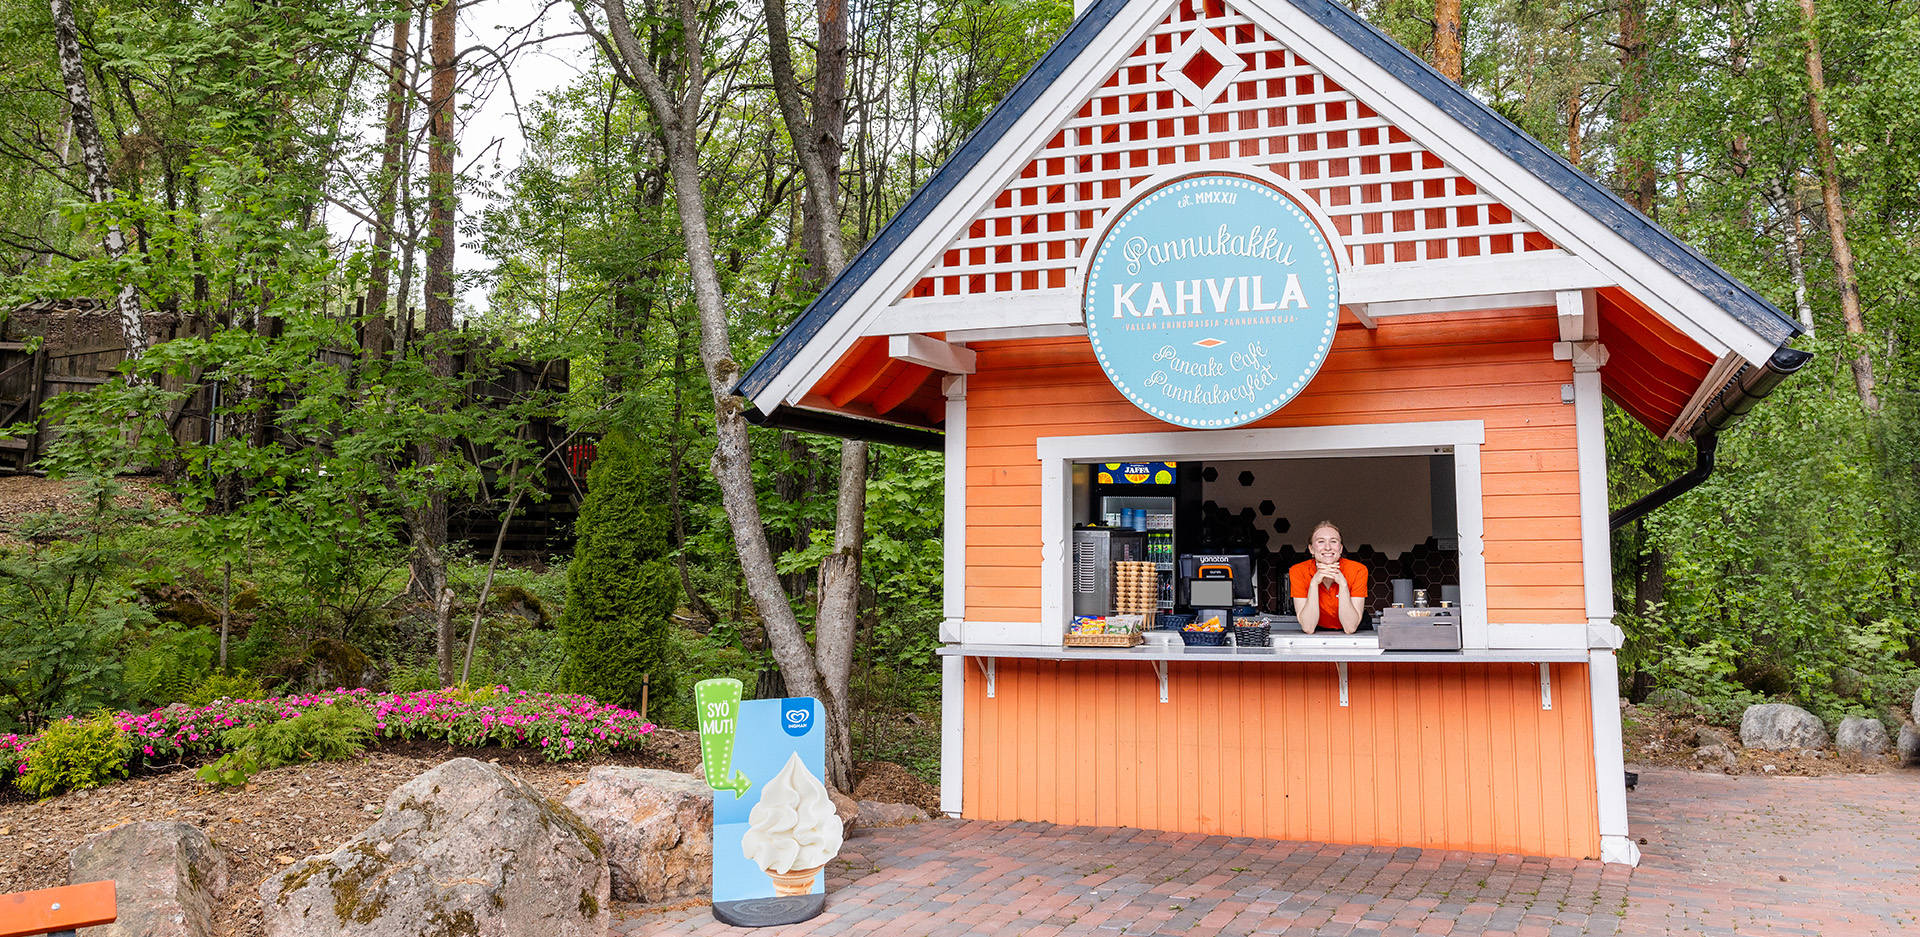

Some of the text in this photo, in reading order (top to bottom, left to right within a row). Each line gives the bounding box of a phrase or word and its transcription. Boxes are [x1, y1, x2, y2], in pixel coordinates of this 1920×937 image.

[1195, 191, 1237, 204] MMXXII
[1123, 224, 1296, 276] Pannukakku
[1112, 273, 1311, 319] KAHVILA
[1152, 341, 1268, 377] Pancake Café
[1124, 466, 1150, 474] JAFFA
[707, 700, 728, 717] SYÖ
[703, 718, 733, 735] MUT!
